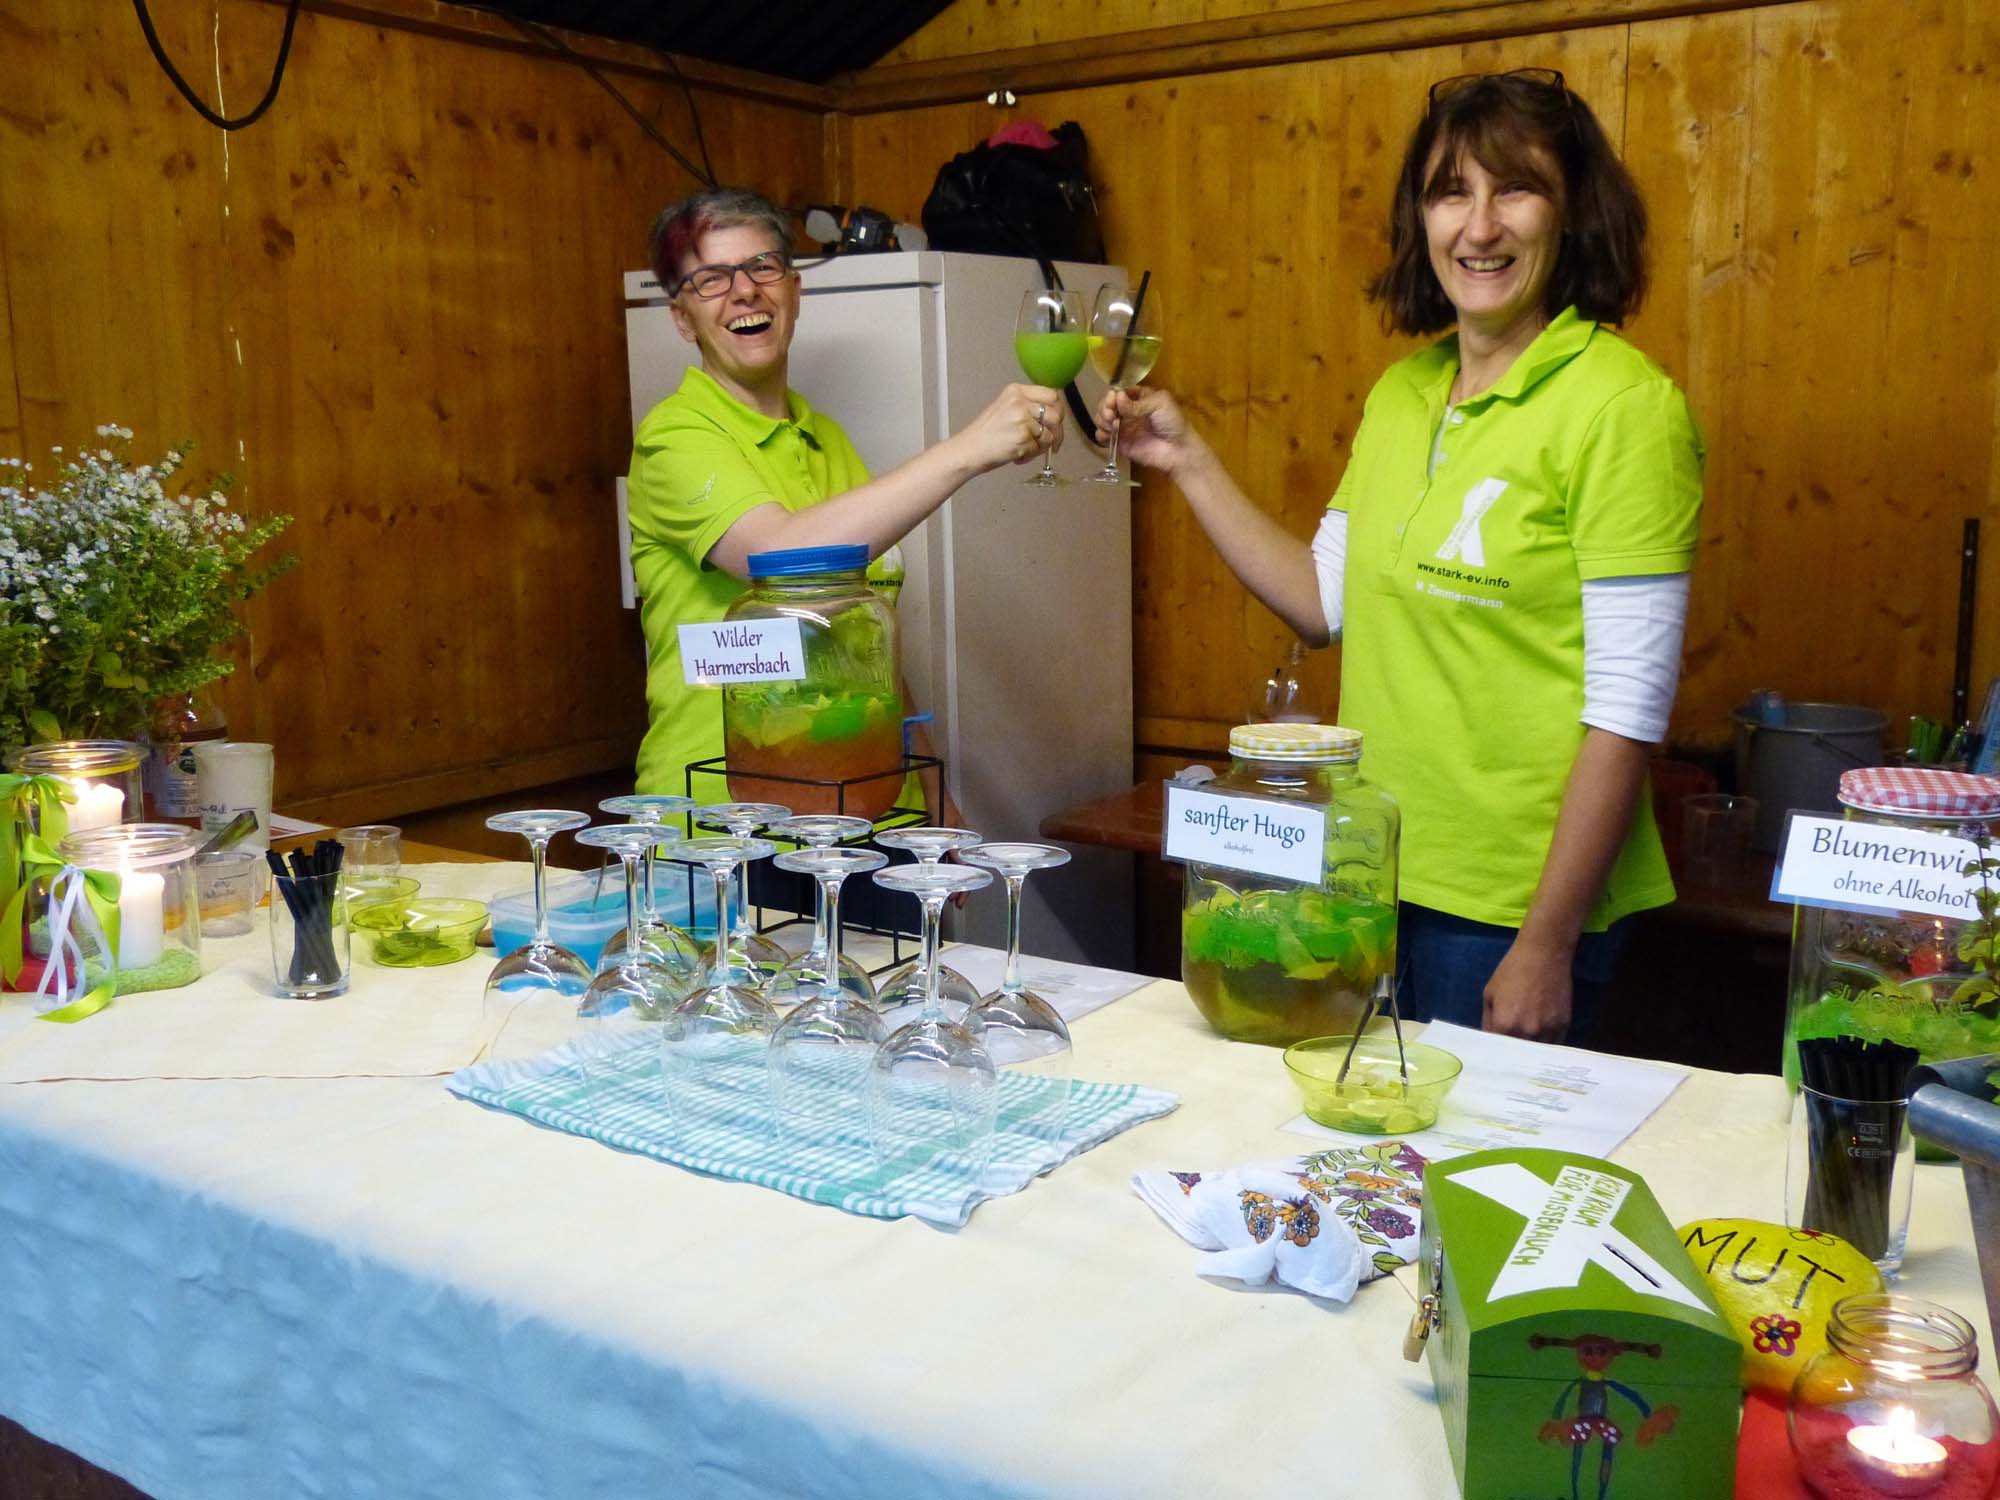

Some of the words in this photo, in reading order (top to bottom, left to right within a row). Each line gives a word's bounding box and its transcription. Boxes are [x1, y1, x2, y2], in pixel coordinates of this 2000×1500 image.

[1417, 562, 1510, 589] www.stark-ev.info
[712, 625, 763, 648] Wilder
[694, 651, 790, 677] Harmersbach
[1184, 804, 1249, 836] sanfter
[1253, 813, 1305, 849] Hugo
[1833, 870, 1884, 895] ohne
[1887, 878, 1975, 909] Alkohol
[1556, 1168, 1592, 1193] FÜR
[1589, 1174, 1624, 1201] KEIN
[1570, 1195, 1613, 1229] RAUM
[1510, 1189, 1575, 1266] MISSBRAUCH
[1684, 1227, 1846, 1310] MUT
